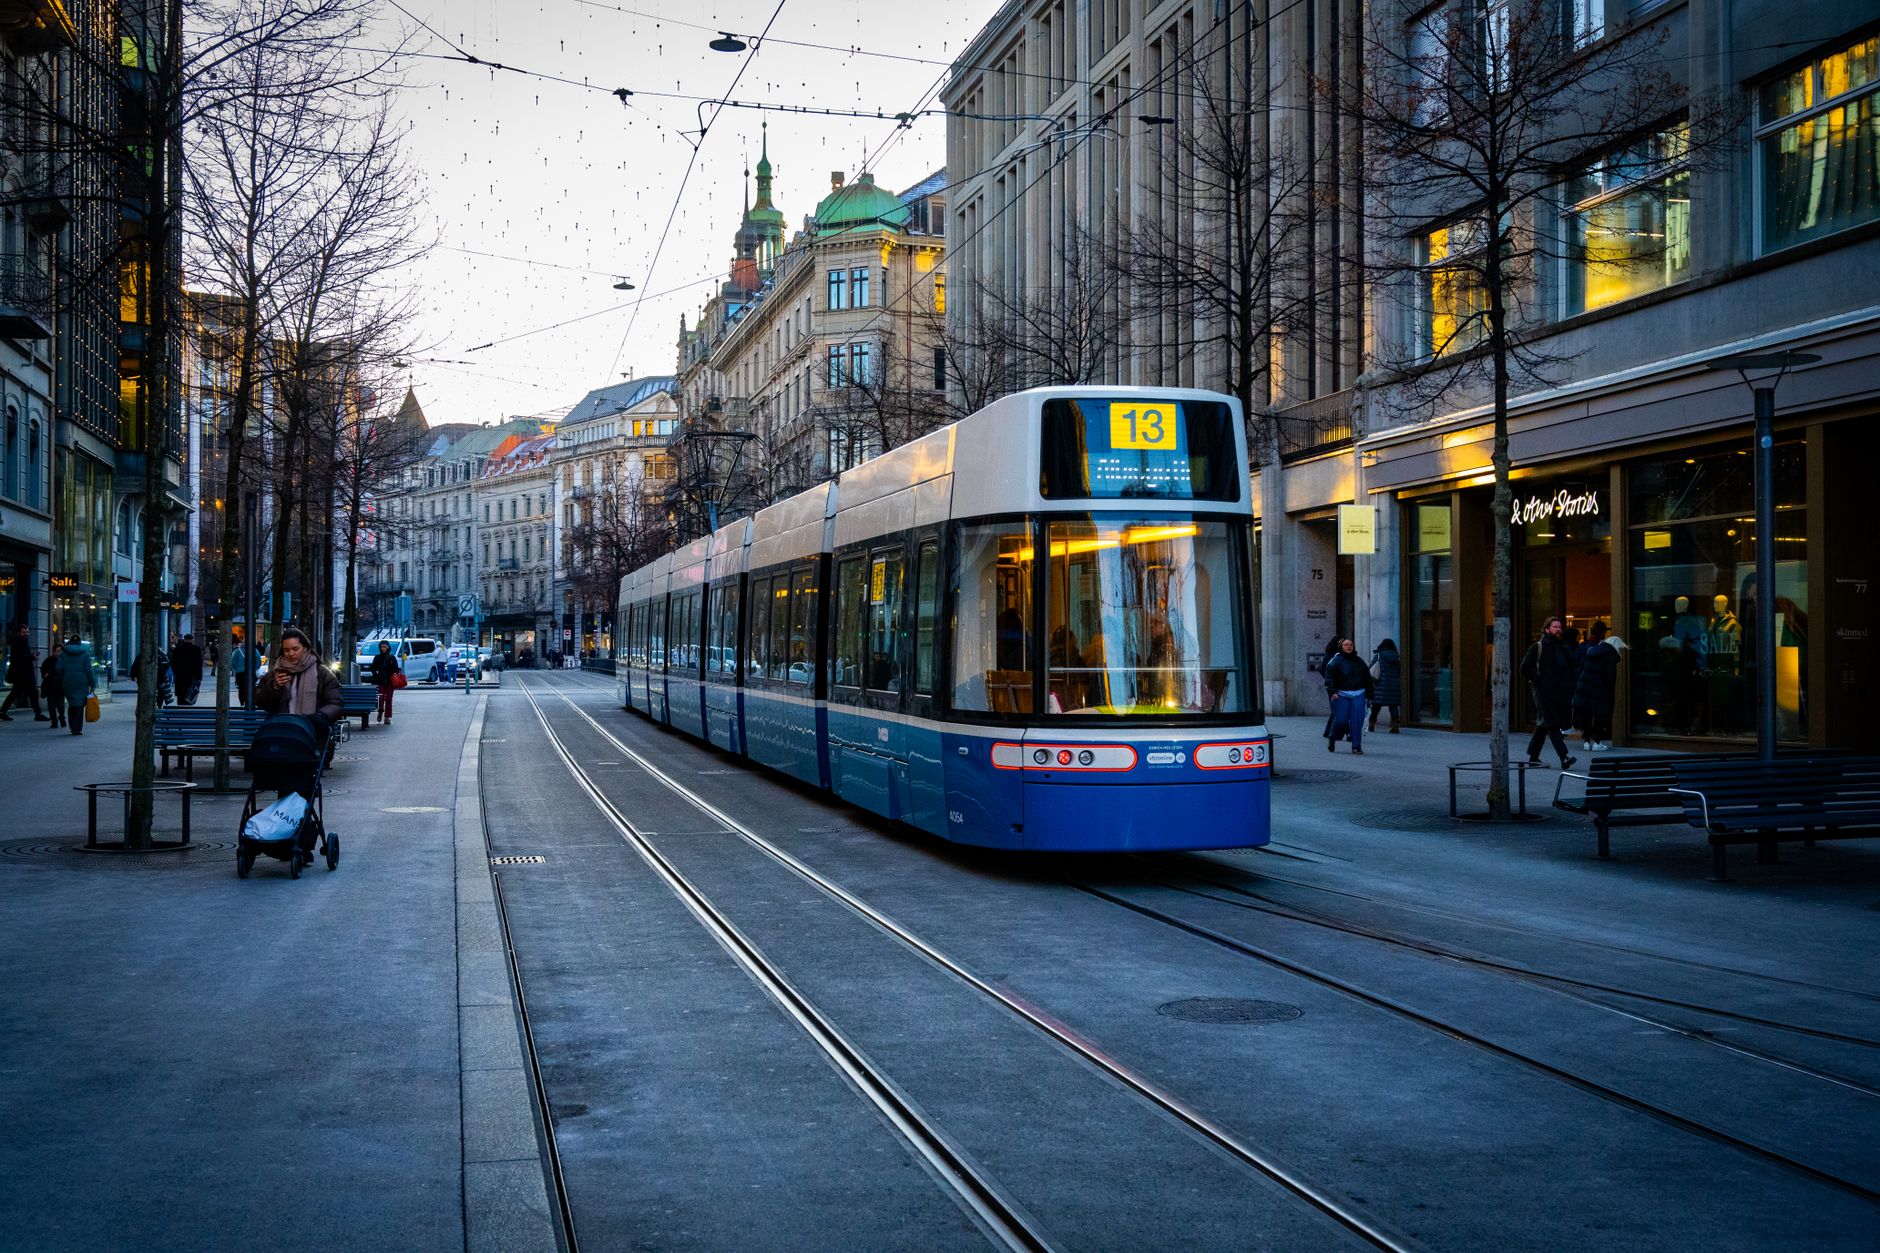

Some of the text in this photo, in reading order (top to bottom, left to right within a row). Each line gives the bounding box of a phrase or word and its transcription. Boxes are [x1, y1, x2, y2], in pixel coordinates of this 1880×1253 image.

[1122, 409, 1164, 444] 13
[1510, 489, 1599, 526] & other Stories
[50, 576, 77, 587] Salt.
[1311, 569, 1324, 580] 75
[1854, 583, 1868, 594] 77
[1699, 632, 1738, 654] SALE
